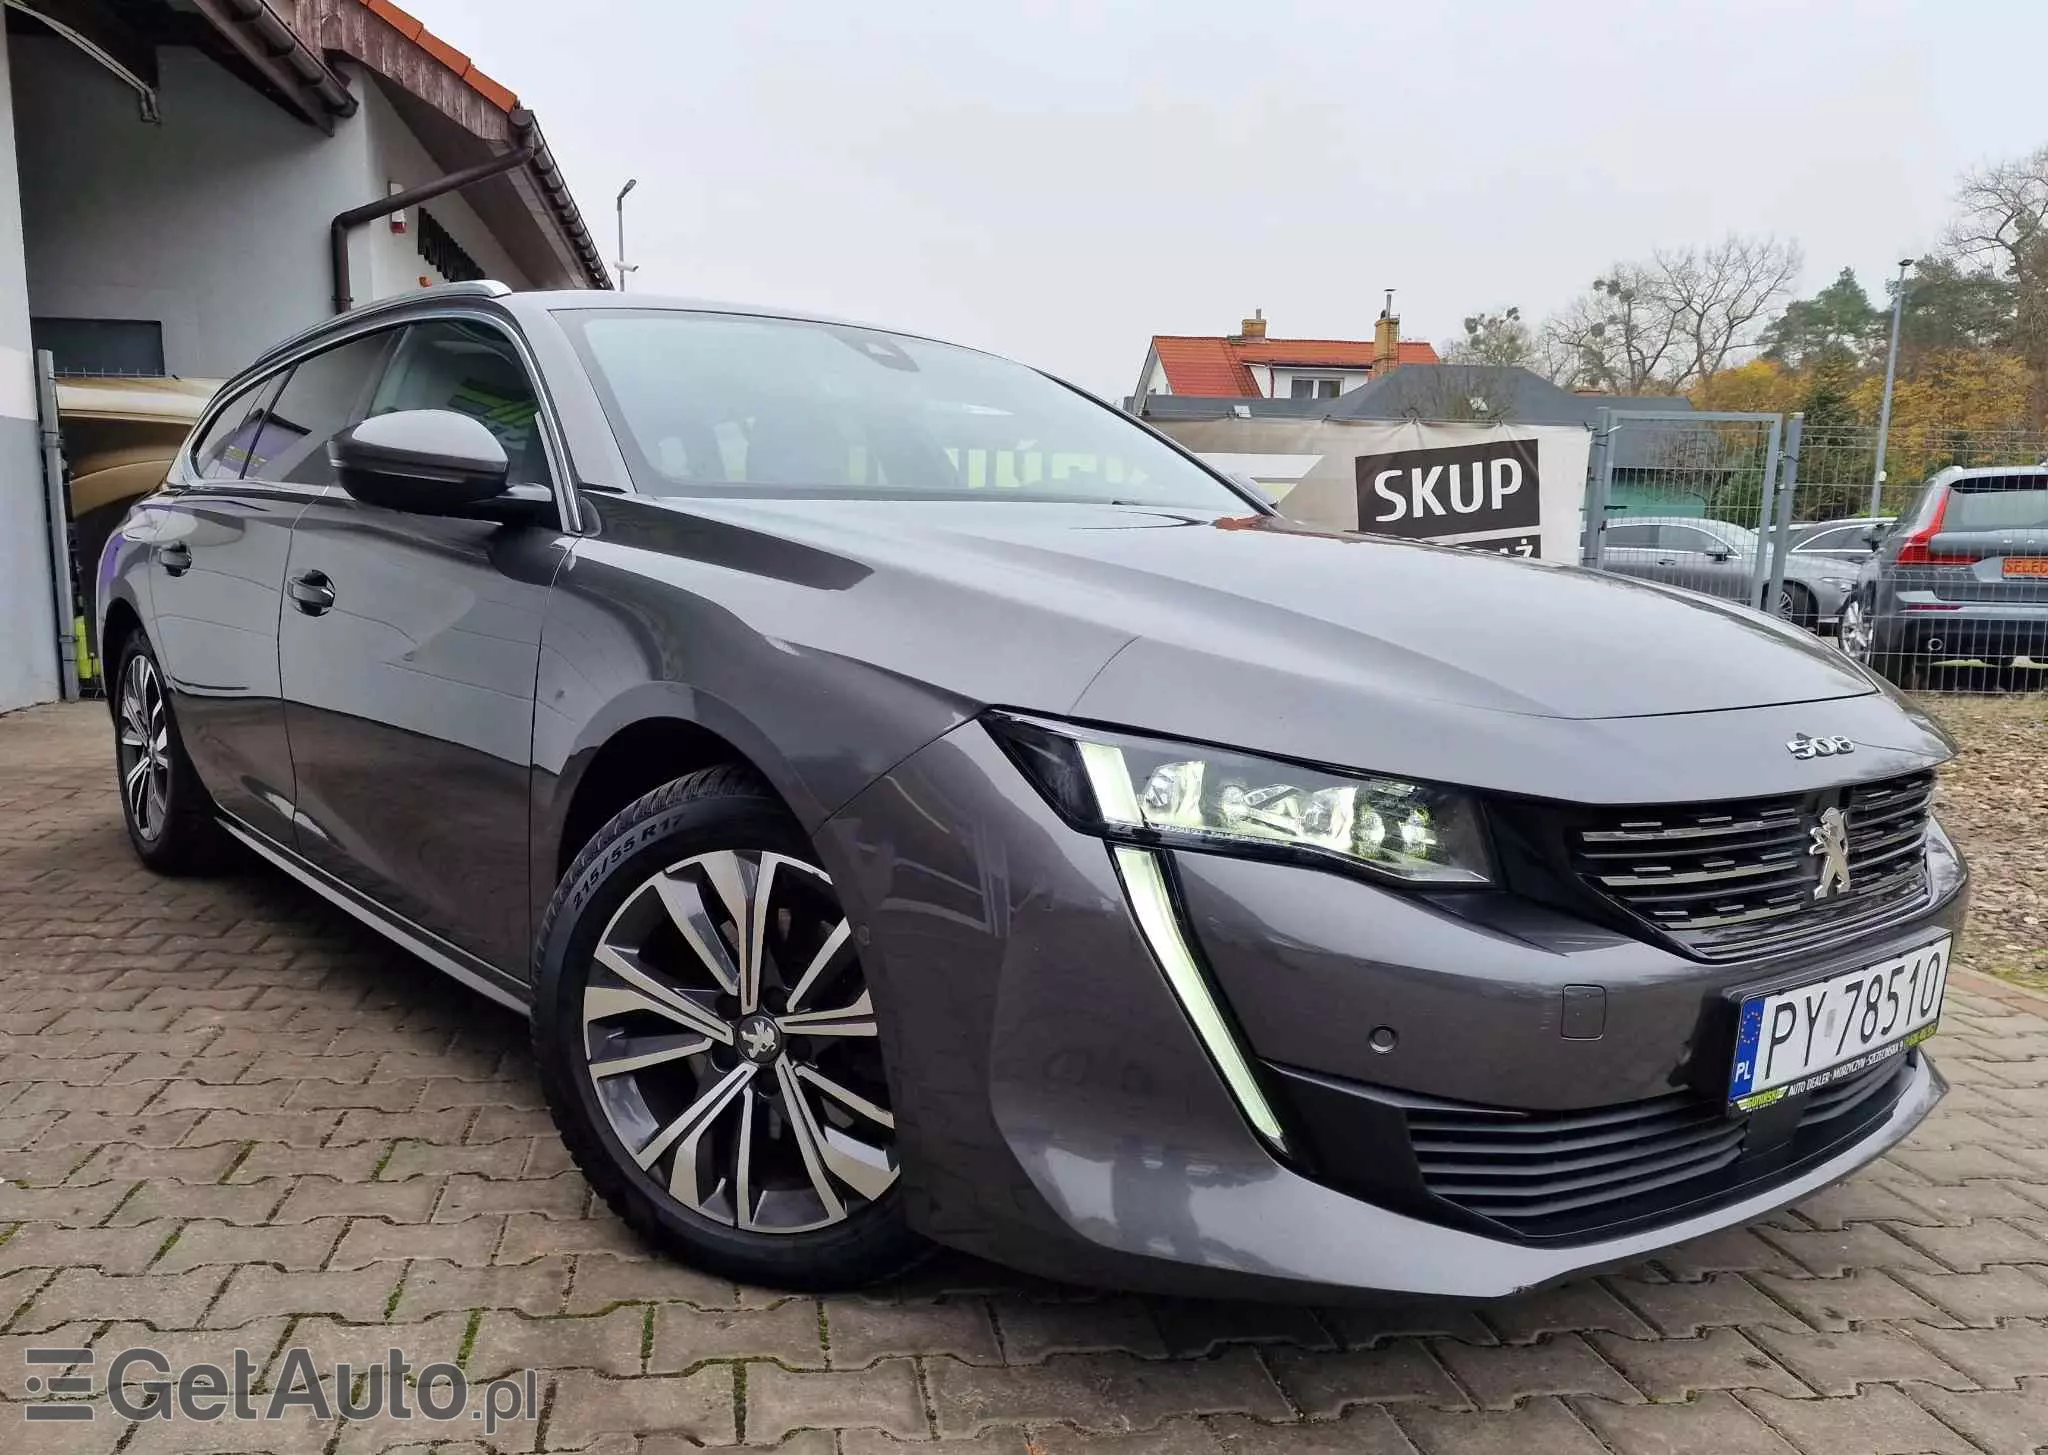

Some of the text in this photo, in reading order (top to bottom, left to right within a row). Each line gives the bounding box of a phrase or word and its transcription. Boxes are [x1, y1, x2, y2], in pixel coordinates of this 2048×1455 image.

[1374, 458, 1523, 522] SKUP
[1785, 735, 1856, 760] 508
[573, 836, 637, 912] 215/55
[1765, 952, 1941, 1080] PY 78510
[1734, 1061, 1752, 1083] PL
[1788, 1080, 1806, 1097] AUTO
